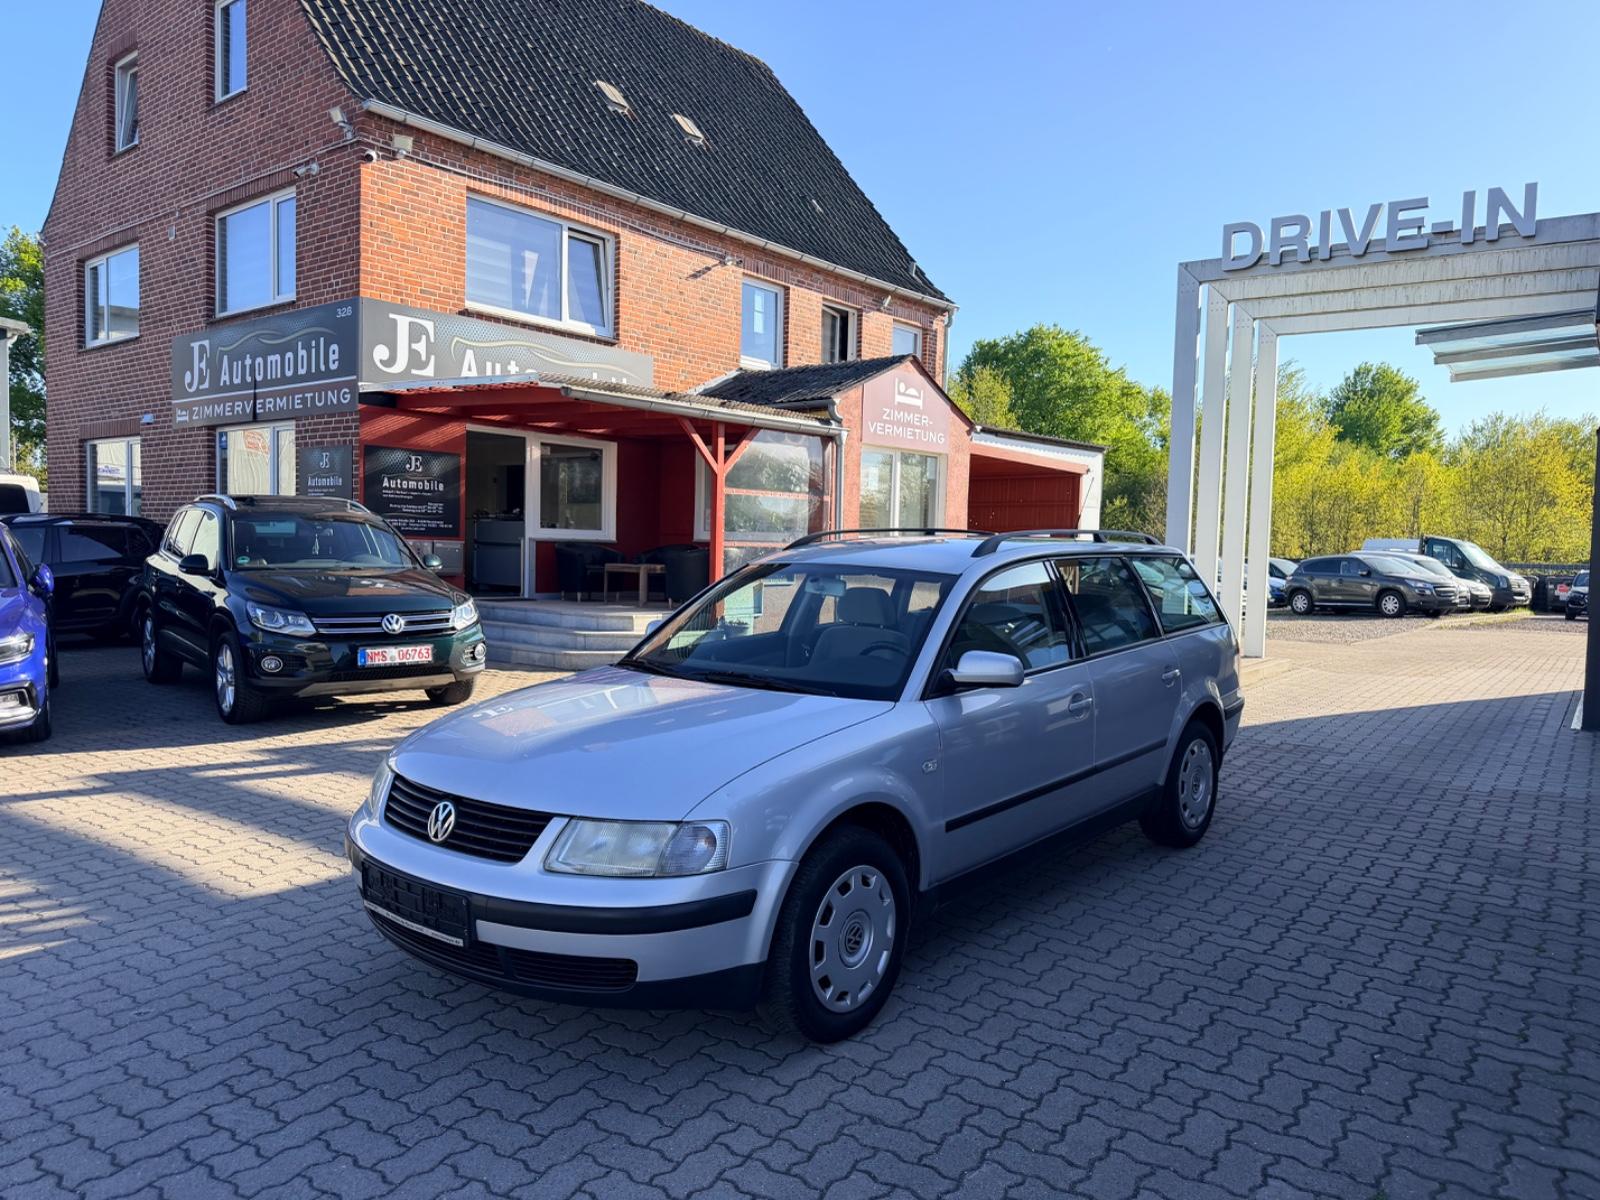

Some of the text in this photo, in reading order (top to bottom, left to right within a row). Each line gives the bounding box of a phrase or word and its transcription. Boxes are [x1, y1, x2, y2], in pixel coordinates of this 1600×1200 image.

[1222, 182, 1538, 271] DRIVE-IN
[220, 337, 339, 386] Automobile
[192, 388, 351, 420] ZIMMERVERMIETUNG
[883, 408, 933, 427] ZIMMER-
[868, 422, 945, 444] VERMIETUNG
[382, 477, 444, 491] Automobile
[367, 647, 431, 662] NMS 06763
